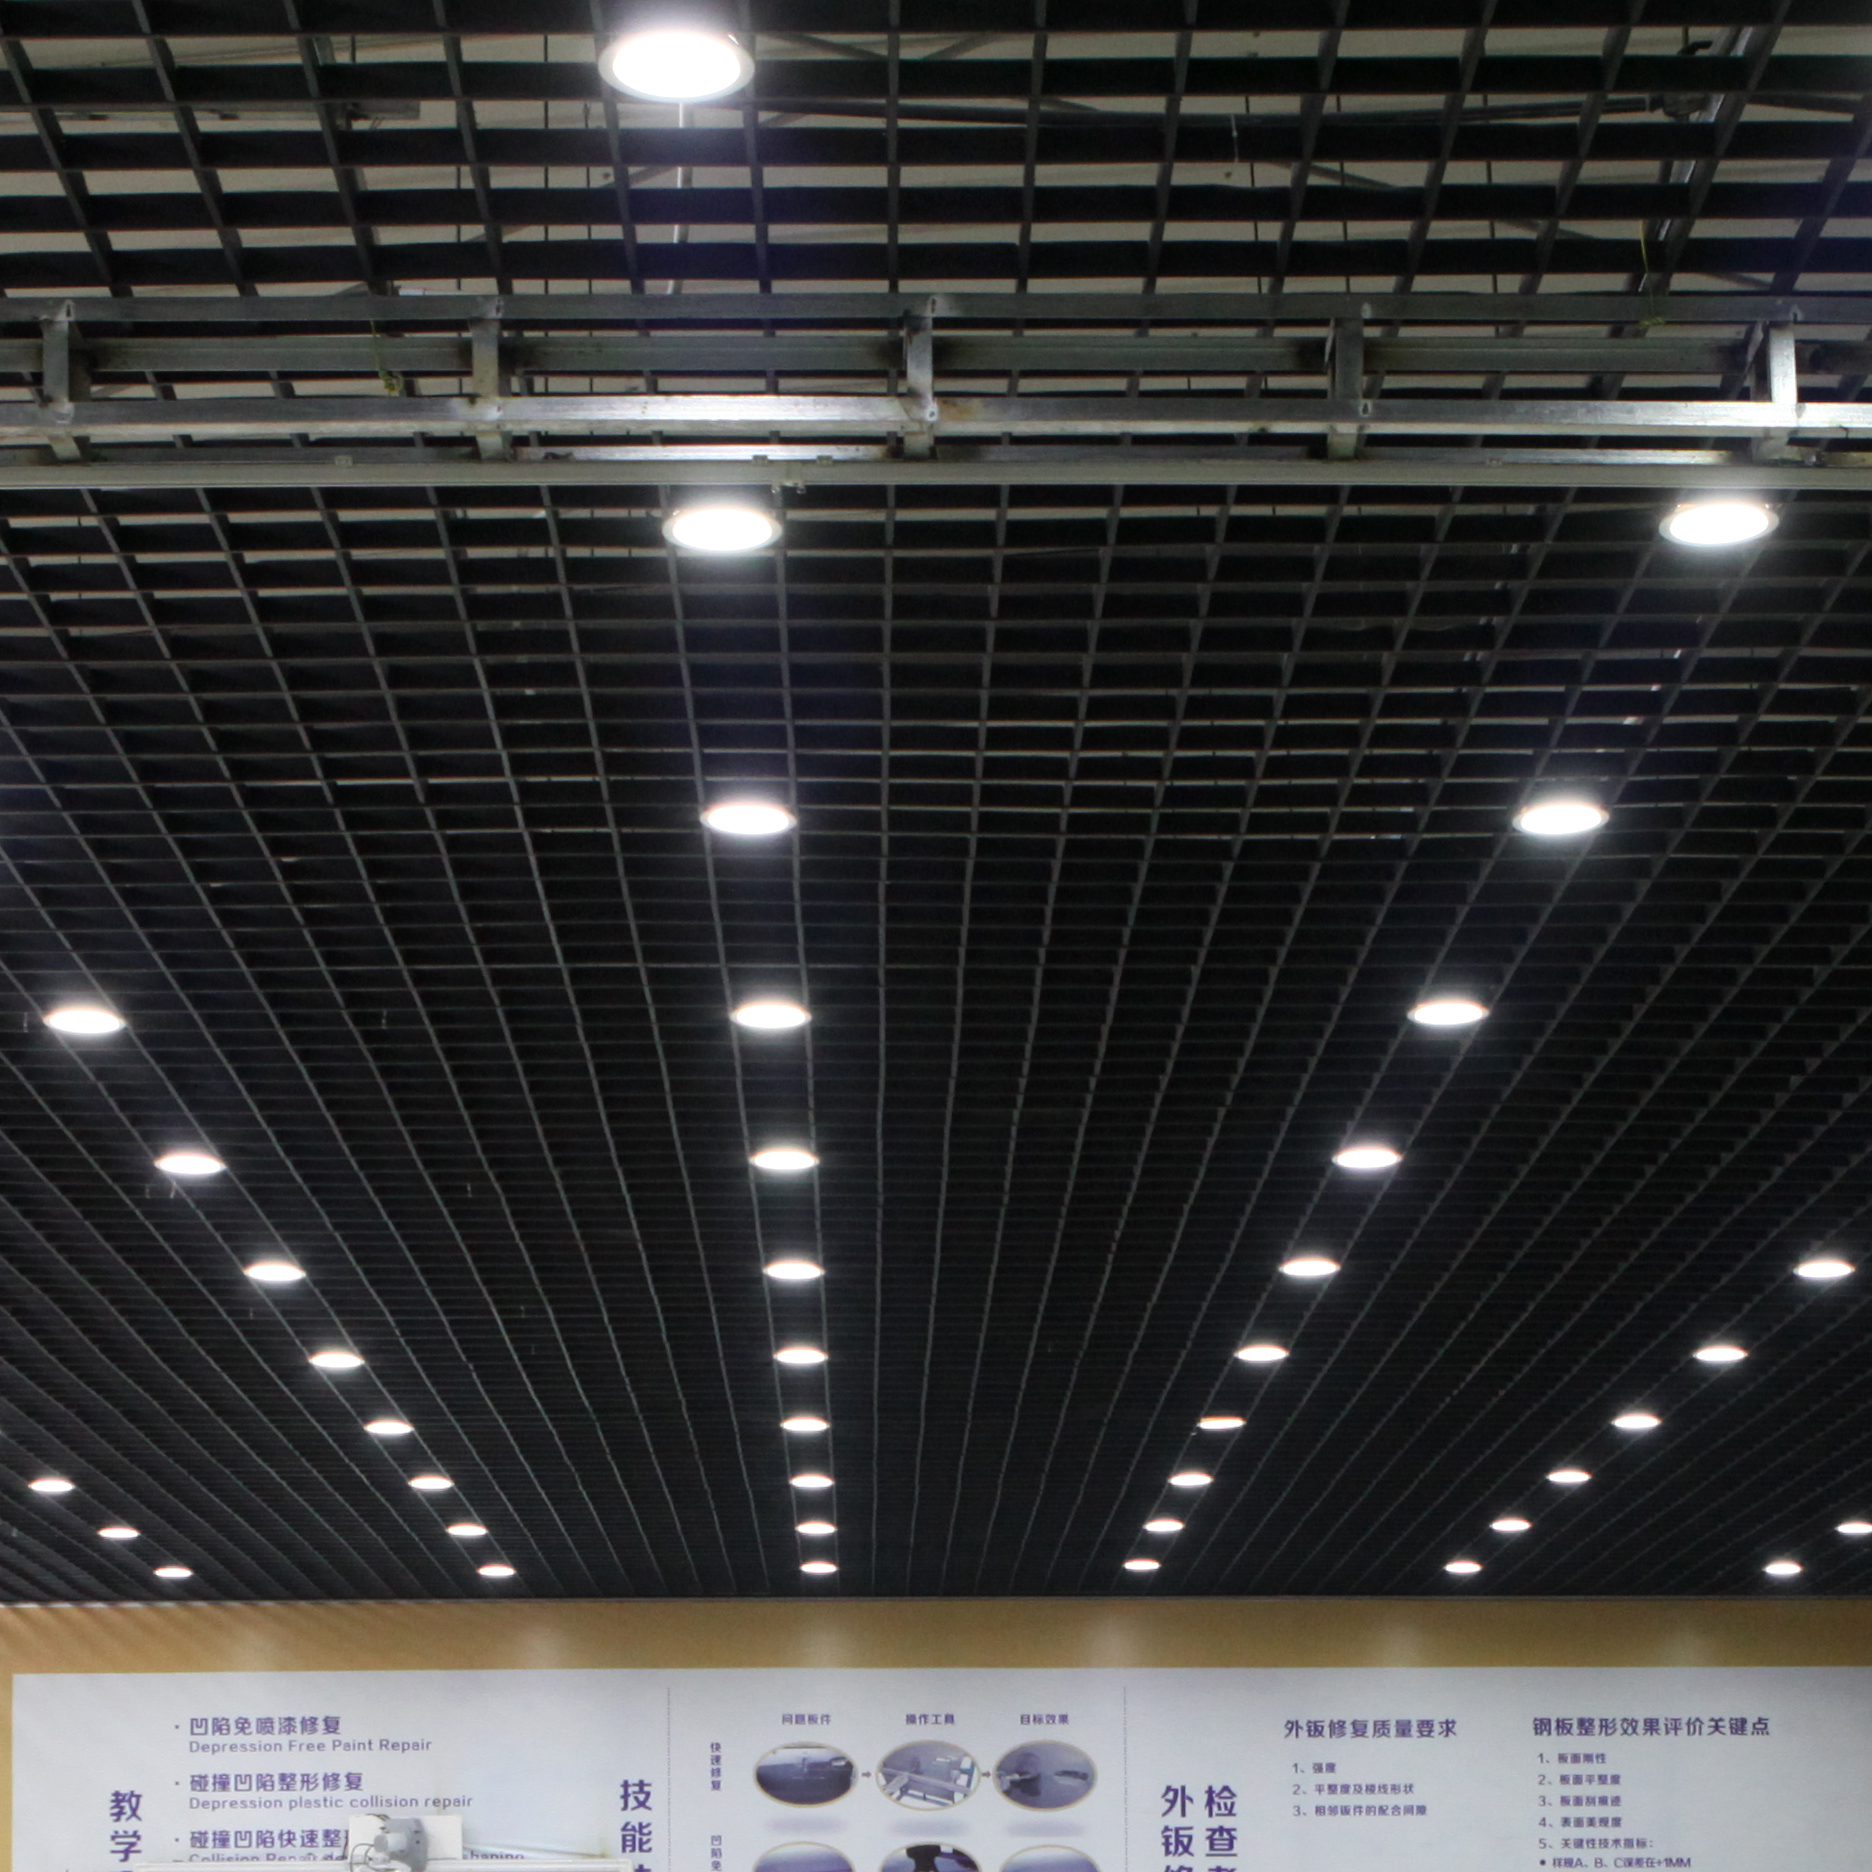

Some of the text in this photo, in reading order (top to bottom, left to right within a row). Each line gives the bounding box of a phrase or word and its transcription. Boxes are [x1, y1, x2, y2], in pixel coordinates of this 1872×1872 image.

[190, 1715, 340, 1735] 凹陷免喷漆修复
[906, 1713, 955, 1724] 操作工具
[1020, 1714, 1068, 1725] 目标效果
[1533, 1717, 1769, 1736] 钢板整形效果评价关键点
[1284, 1719, 1456, 1738] 外钣修复质量要求
[189, 1739, 431, 1755] Depression Free Paint Repair
[710, 1742, 721, 1790] 快速修复
[1293, 1762, 1336, 1773] 1、强度
[190, 1772, 362, 1792] 碰撞凹陷整形修复
[189, 1795, 472, 1811] Depression plastic collision repair
[188, 1829, 349, 1849] 碰撞凹陷快速整
